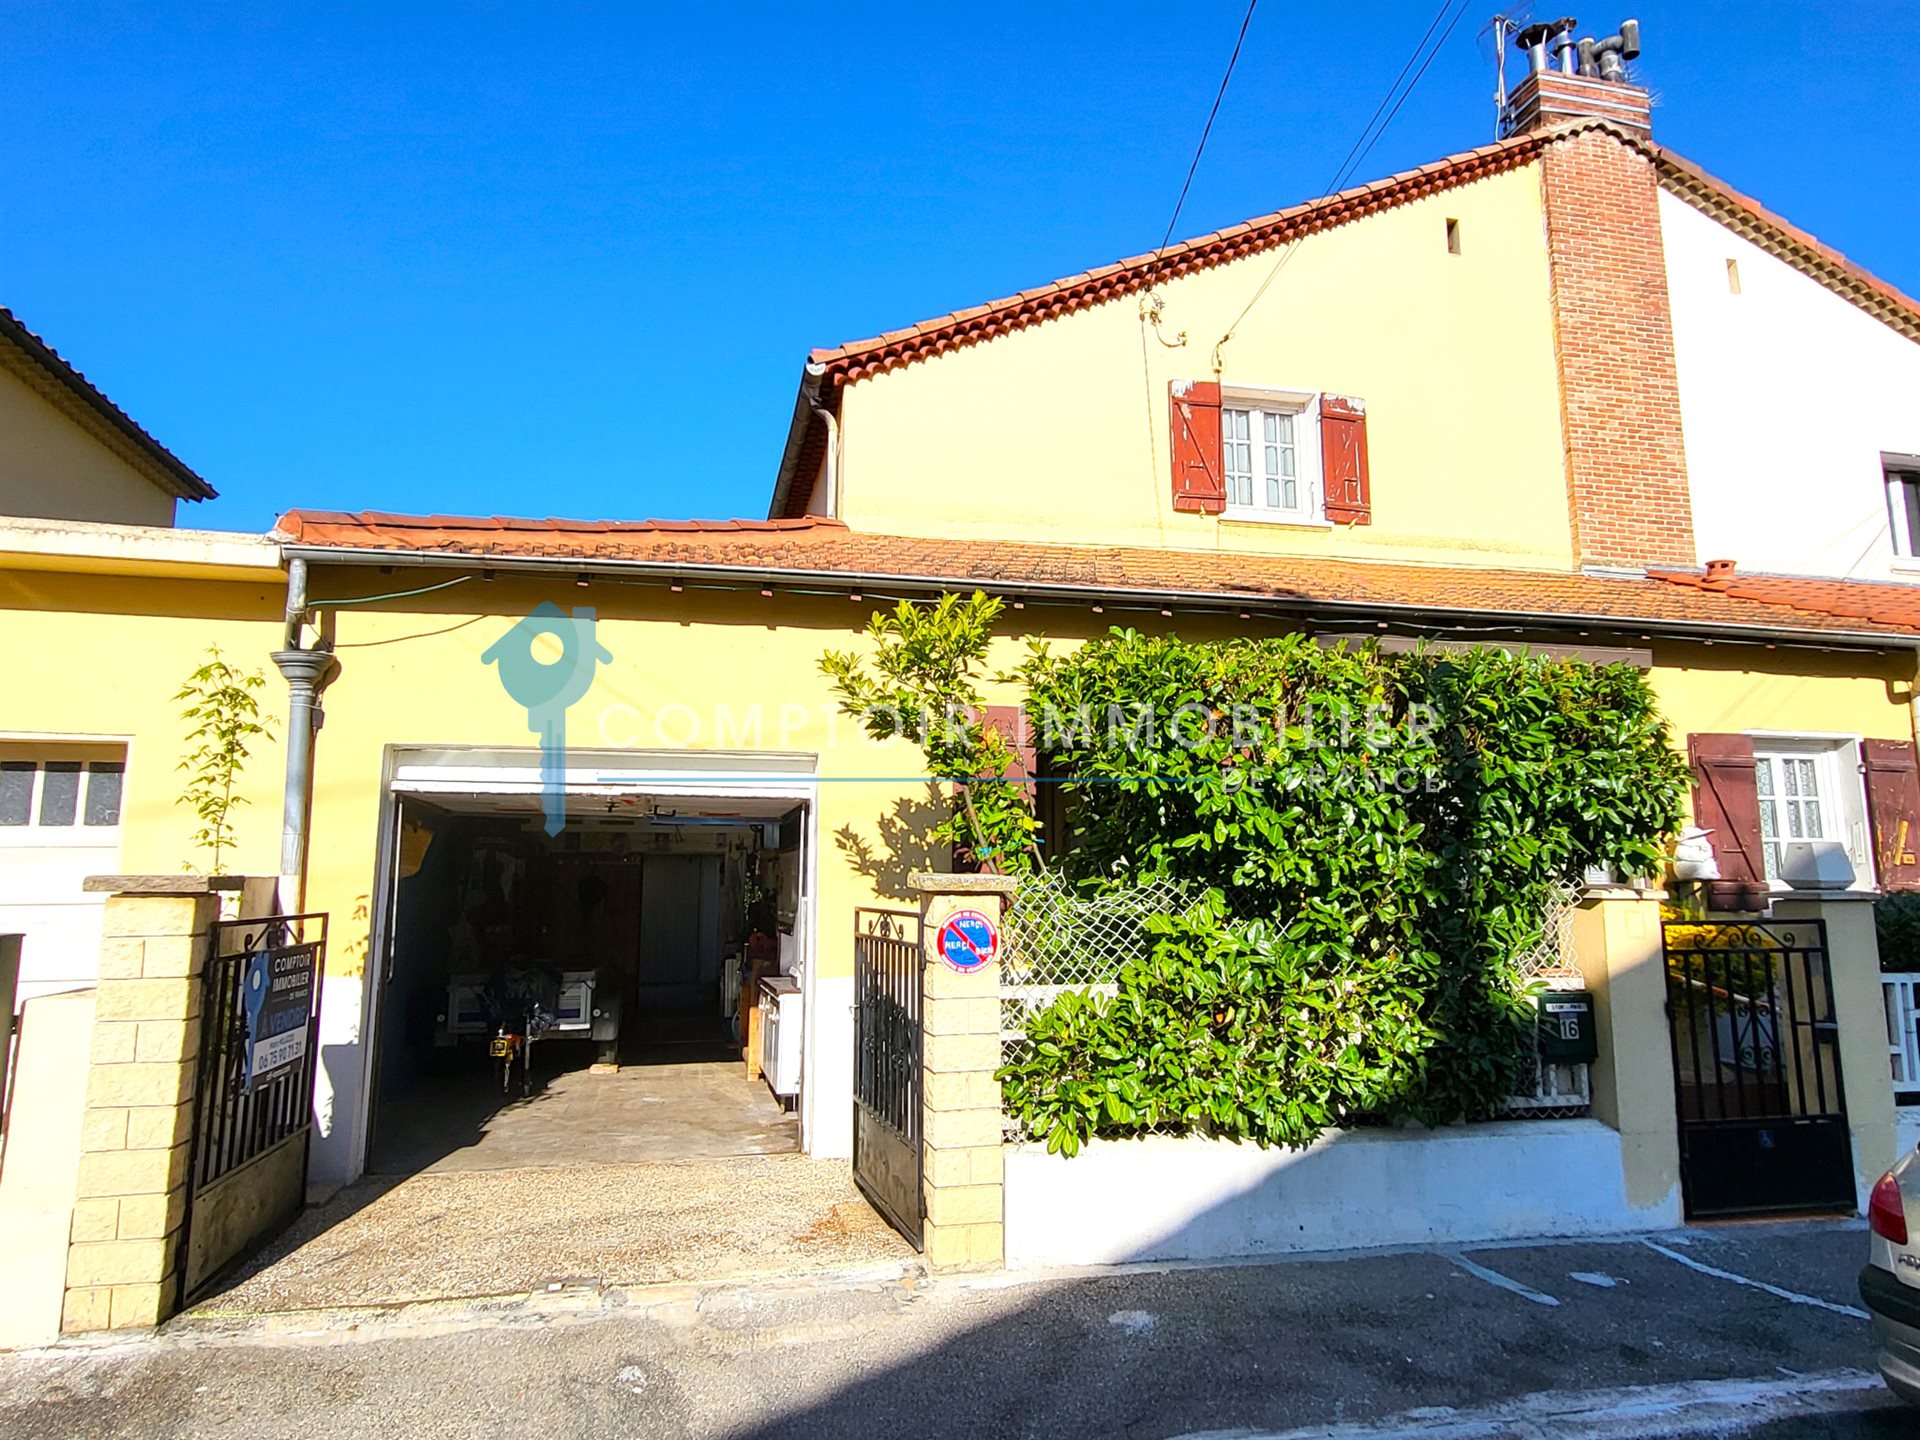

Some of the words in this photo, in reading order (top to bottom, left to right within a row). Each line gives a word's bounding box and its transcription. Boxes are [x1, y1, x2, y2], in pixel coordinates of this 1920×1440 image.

[274, 953, 311, 972] COMPTOIR
[272, 971, 310, 993] IMMOBILIER
[270, 1005, 306, 1033] VENDRE
[1562, 1021, 1577, 1037] 16
